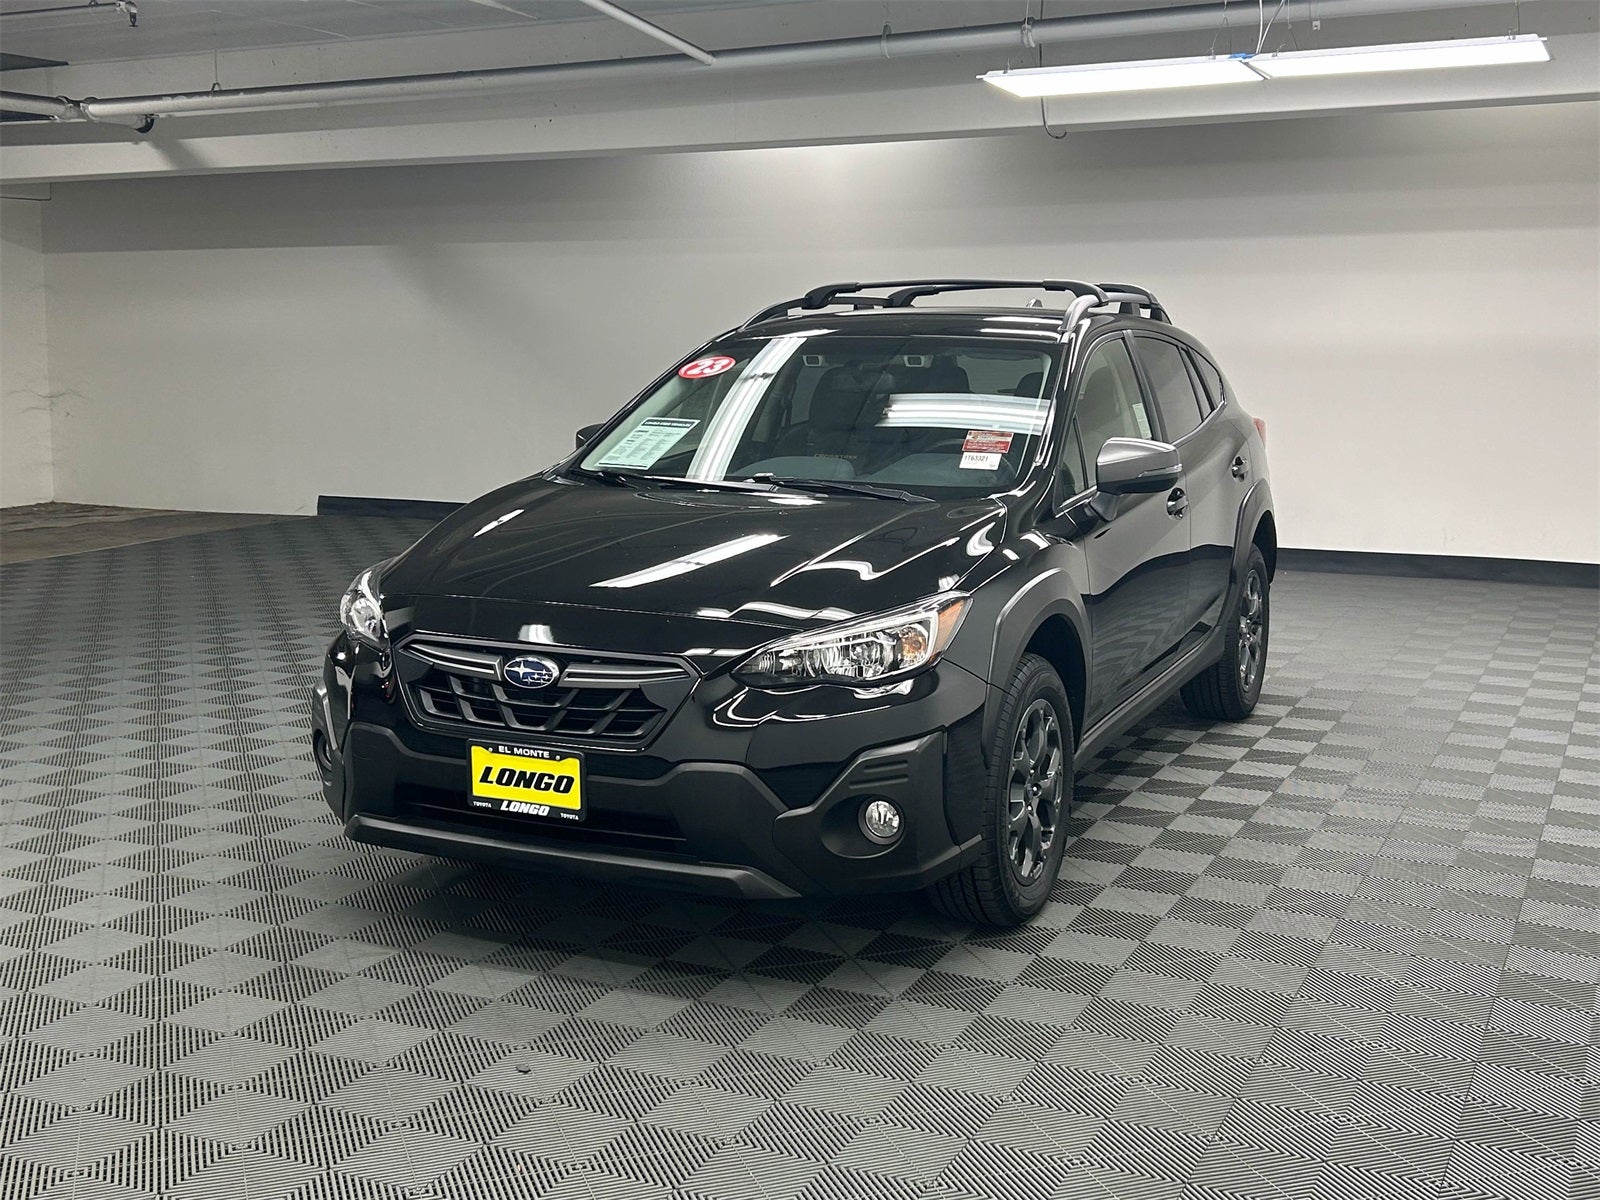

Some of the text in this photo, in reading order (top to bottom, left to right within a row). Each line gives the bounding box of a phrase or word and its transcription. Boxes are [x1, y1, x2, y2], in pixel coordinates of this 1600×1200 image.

[686, 359, 730, 375] 23
[513, 748, 550, 758] MONTE
[479, 766, 575, 794] LONGO
[500, 800, 550, 816] LONGO
